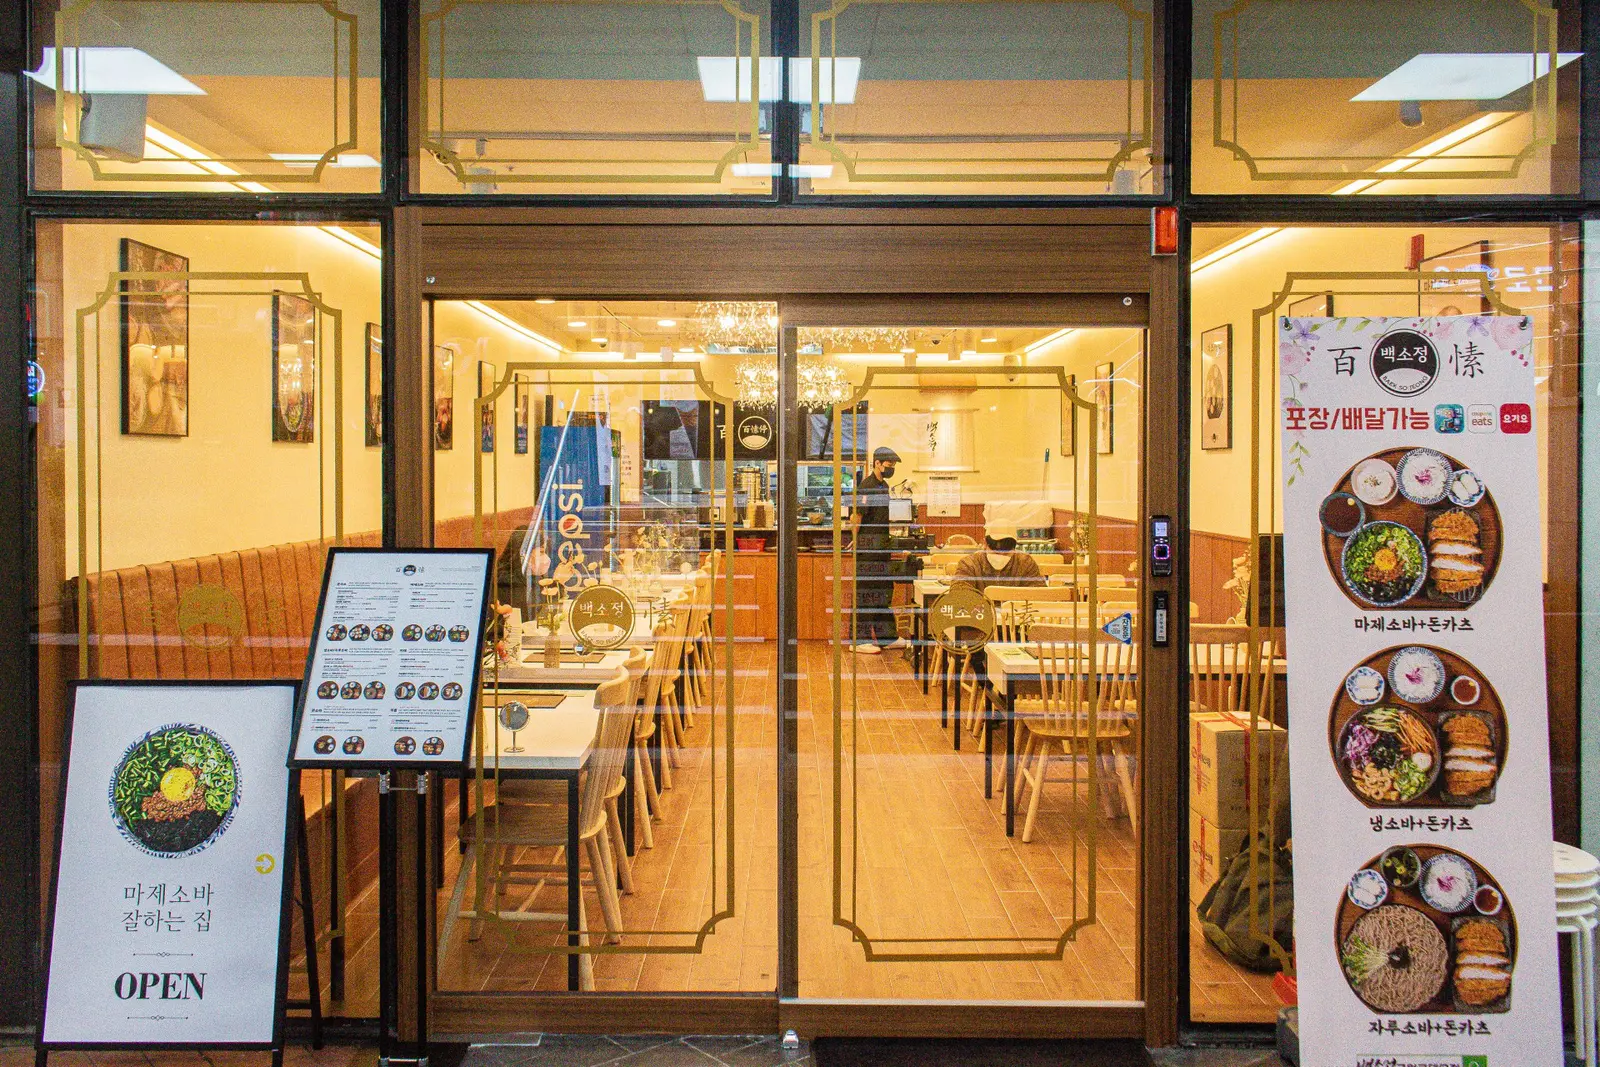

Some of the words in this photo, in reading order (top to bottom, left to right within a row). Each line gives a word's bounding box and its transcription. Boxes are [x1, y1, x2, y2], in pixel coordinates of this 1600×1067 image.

[1327, 345, 1362, 377] 百
[1380, 345, 1428, 363] 백소정
[1286, 406, 1430, 432] 포장/배달가능
[1471, 417, 1493, 426] eats
[1502, 414, 1528, 424] 요기요
[579, 600, 624, 618] 백소정
[1354, 615, 1474, 633] 마제소바+돈카츠
[1369, 815, 1473, 833] 냉소바+돈카츠
[123, 882, 214, 907] 마제소바
[121, 909, 185, 934] 잘하는
[194, 909, 213, 933] 집
[114, 972, 207, 1000] OPEN
[1367, 1019, 1492, 1037] 자루소바+돈카츠
